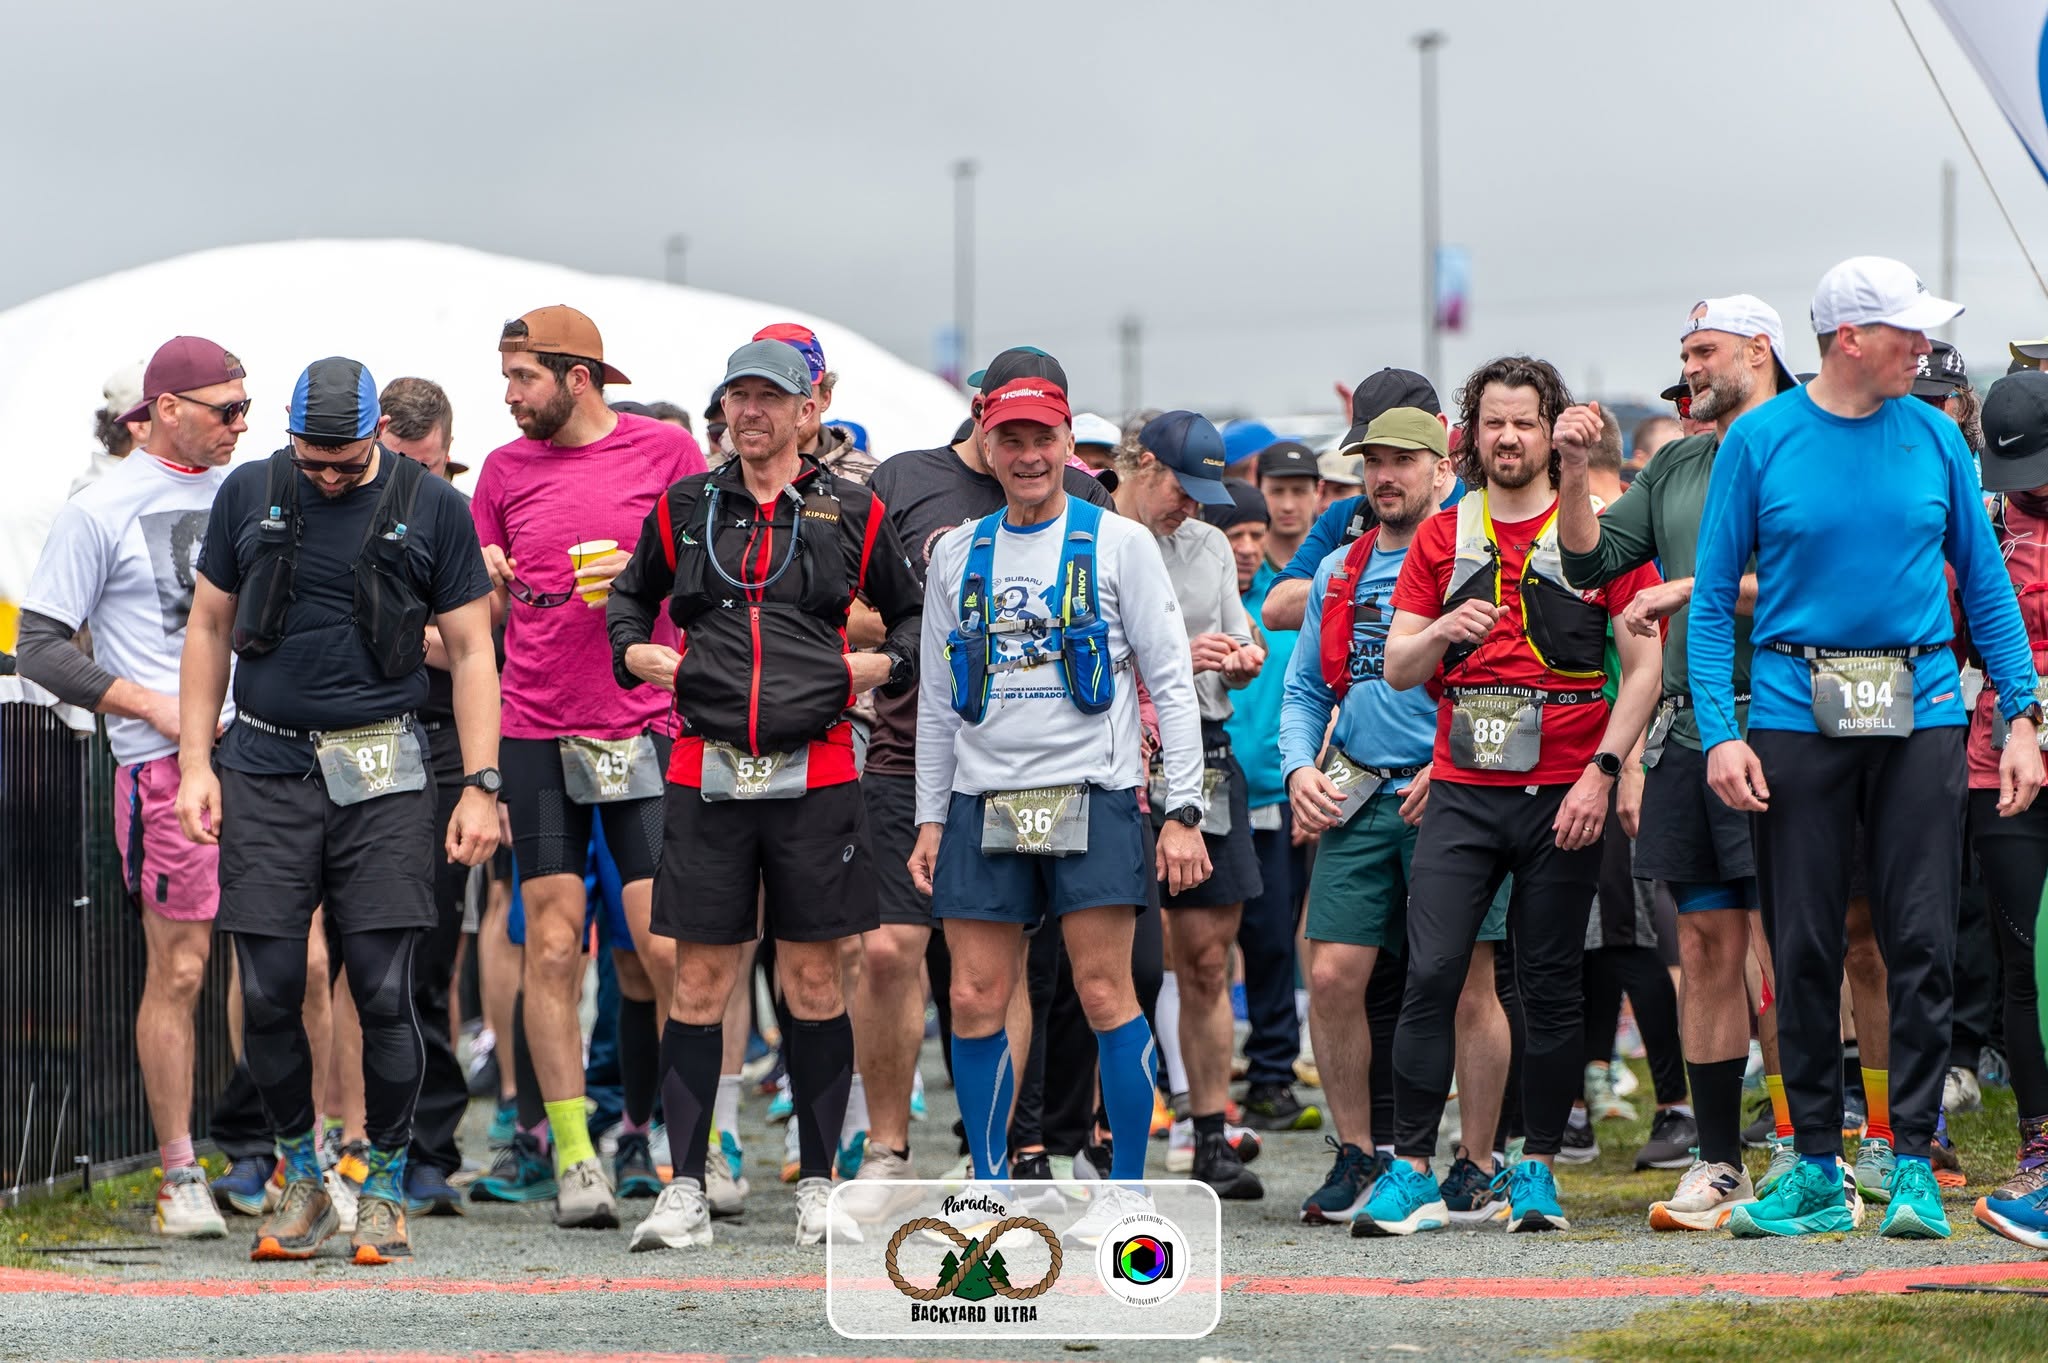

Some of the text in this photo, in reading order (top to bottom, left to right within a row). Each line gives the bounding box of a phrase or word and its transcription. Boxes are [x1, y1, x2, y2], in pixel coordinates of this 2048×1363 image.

[805, 510, 838, 521] KIPRUN
[1004, 575, 1043, 586] SUBARU
[1839, 681, 1893, 708] 194
[1473, 718, 1506, 744] 88
[1838, 718, 1895, 730] RUSSELL
[356, 743, 390, 773] 87
[595, 750, 628, 776] 45
[1473, 752, 1504, 764] JOHN
[738, 756, 773, 778] 53
[367, 777, 398, 792] JOEL
[600, 782, 630, 796] MIKE
[735, 783, 771, 793] KILEY
[1017, 808, 1052, 834] 36
[1016, 843, 1052, 853] CHRIS
